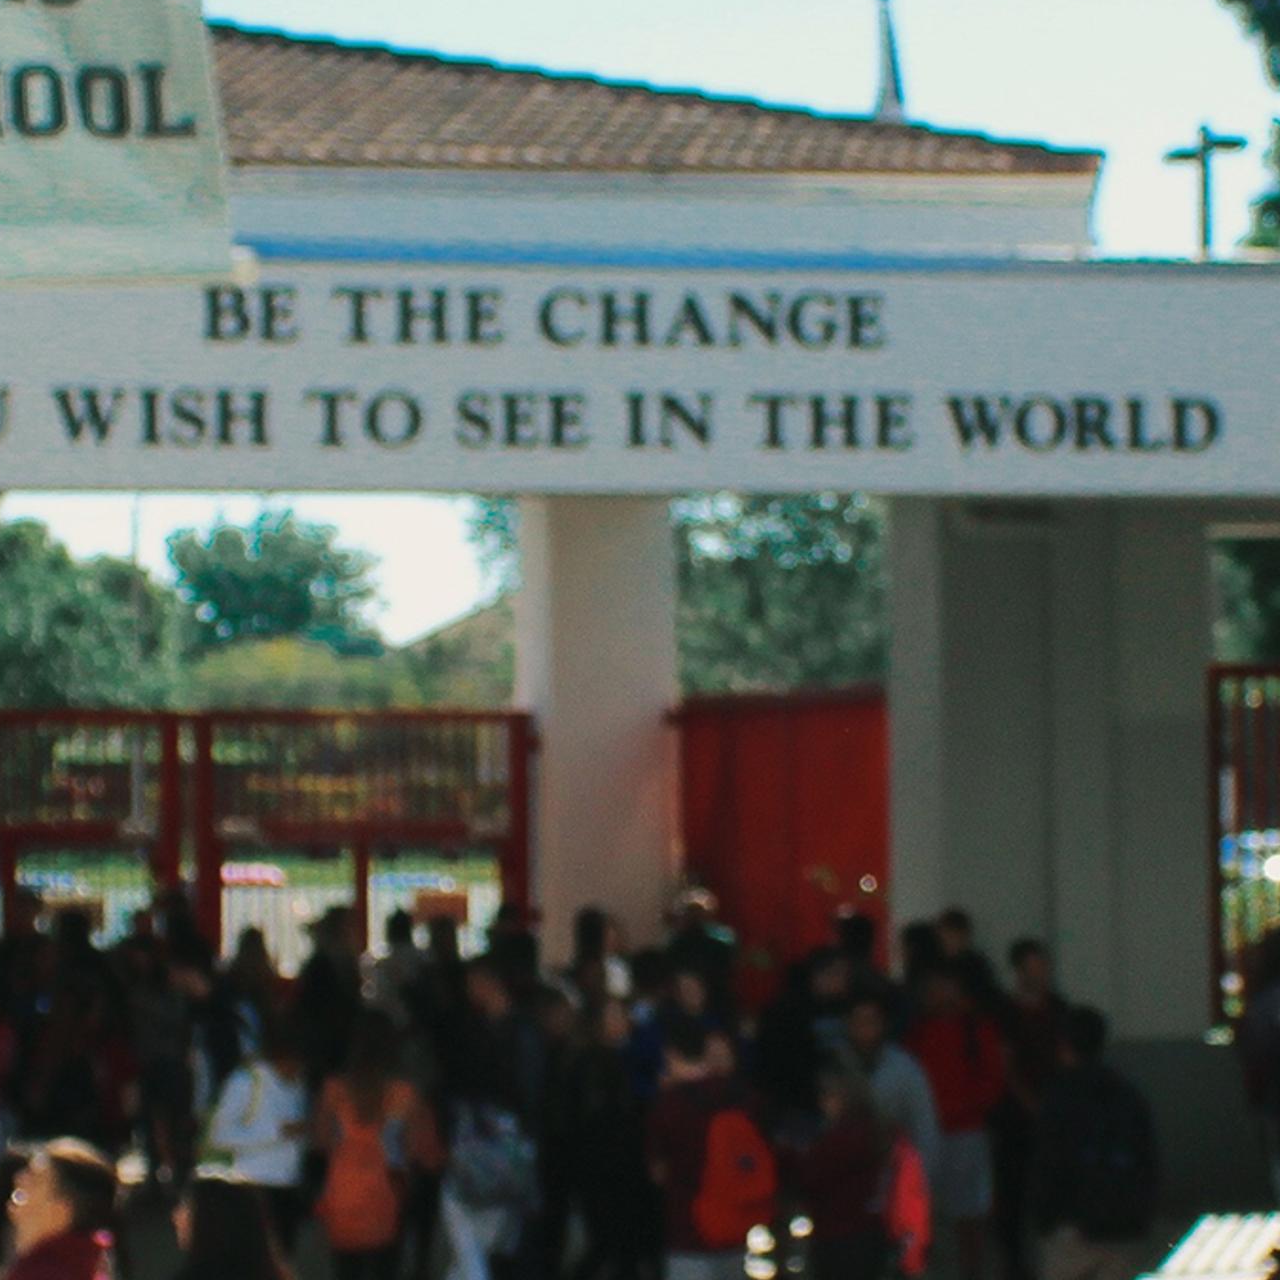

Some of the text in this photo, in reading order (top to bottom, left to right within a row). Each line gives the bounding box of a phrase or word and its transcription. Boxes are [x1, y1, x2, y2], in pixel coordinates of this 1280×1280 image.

[202, 283, 887, 352] BE THE CHANGE
[50, 385, 271, 449] WISH
[305, 387, 426, 450] TO
[453, 389, 590, 451] SEE
[623, 389, 715, 452] IN
[747, 391, 915, 453] THE
[943, 393, 1226, 455] WORLD
